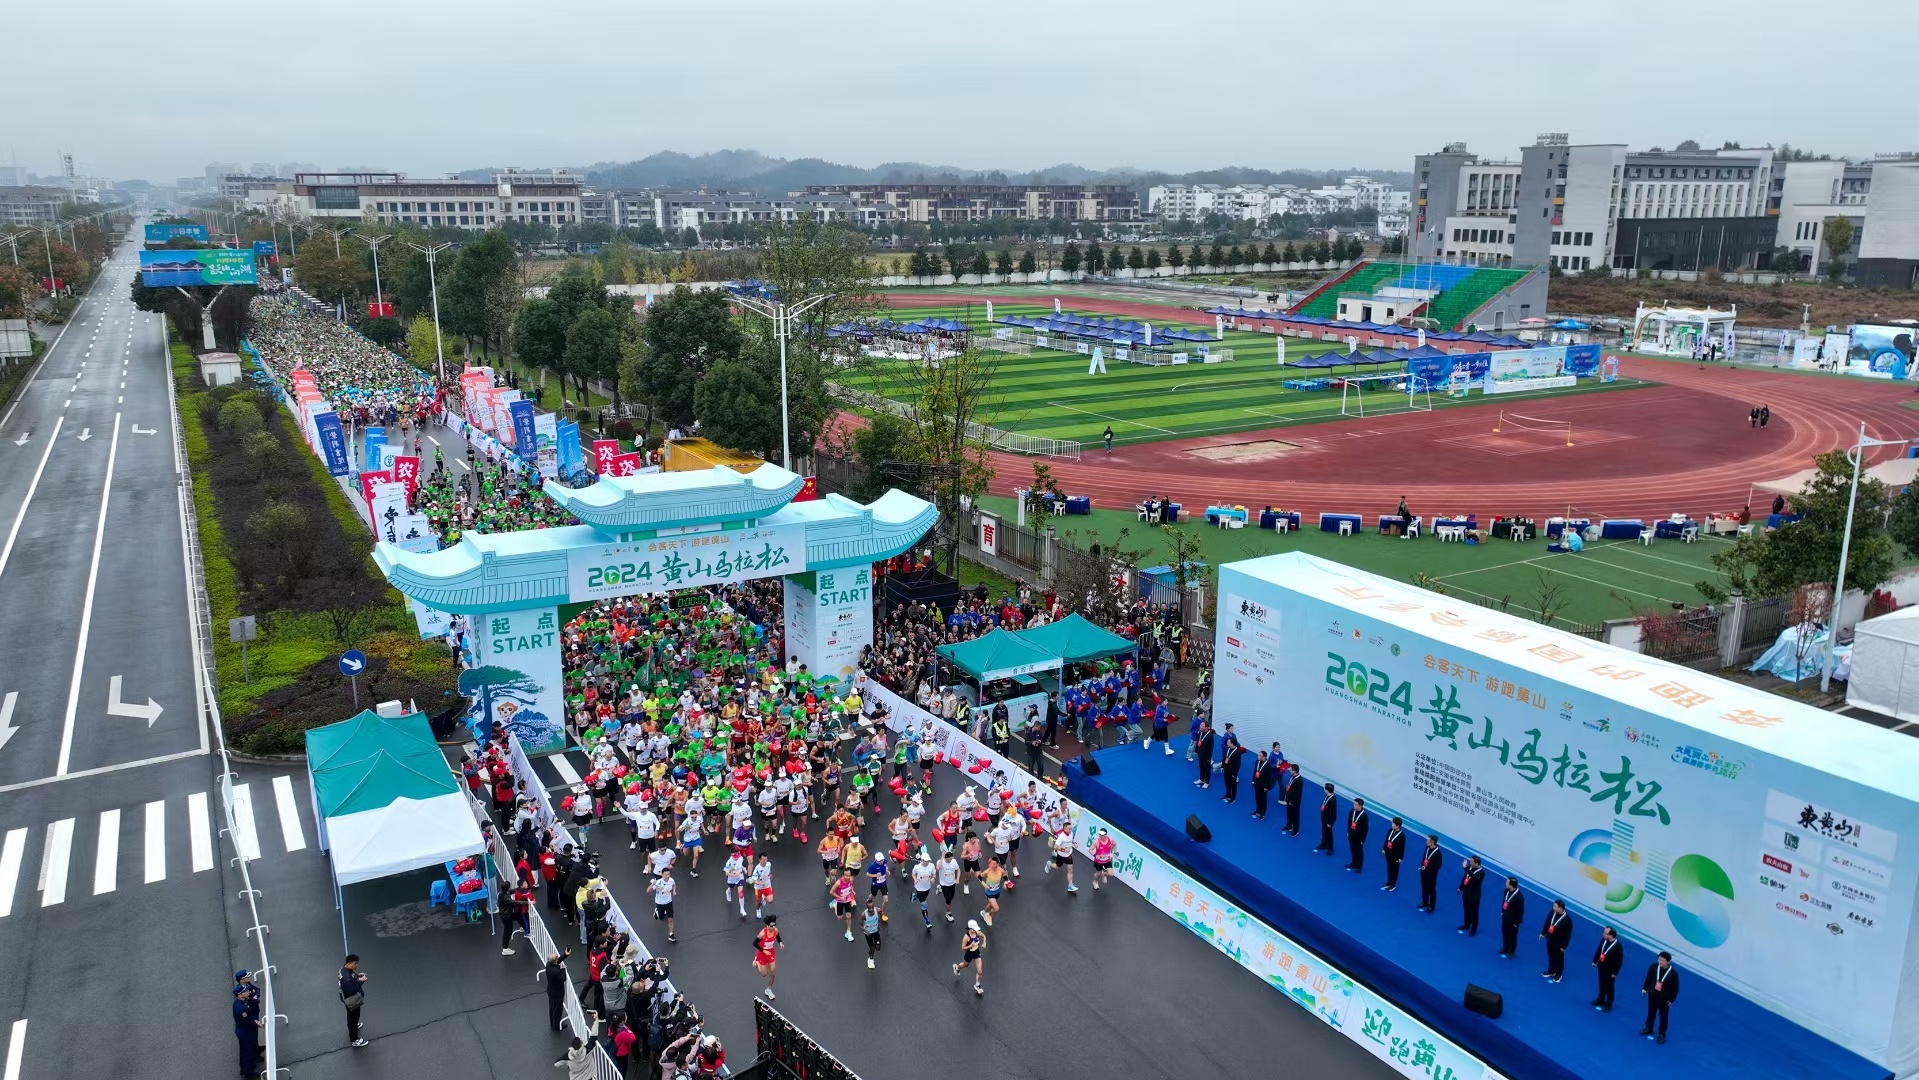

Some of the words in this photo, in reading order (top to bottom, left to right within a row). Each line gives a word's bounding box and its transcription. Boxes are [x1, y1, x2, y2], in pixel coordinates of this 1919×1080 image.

[648, 539, 687, 552] 会客天下
[983, 523, 995, 547] 育
[588, 561, 652, 588] 2024
[656, 543, 790, 587] 黄山马拉松
[819, 574, 834, 591] 起
[855, 569, 869, 585] 点
[677, 596, 708, 608] 0:00:05
[820, 587, 870, 607] START
[491, 618, 510, 636] 起
[537, 611, 555, 630] 点
[493, 631, 555, 654] START
[1423, 653, 1480, 684] 会客天下
[1485, 675, 1548, 711] 游跑黄山
[1325, 686, 1369, 709] HUANGSHAN
[1371, 704, 1413, 727] MARATHON
[1326, 651, 1413, 716] 2024
[1419, 684, 1671, 826] 黄山马拉松
[1168, 881, 1226, 925] 会客天下
[1262, 937, 1328, 994] 游跑黄山
